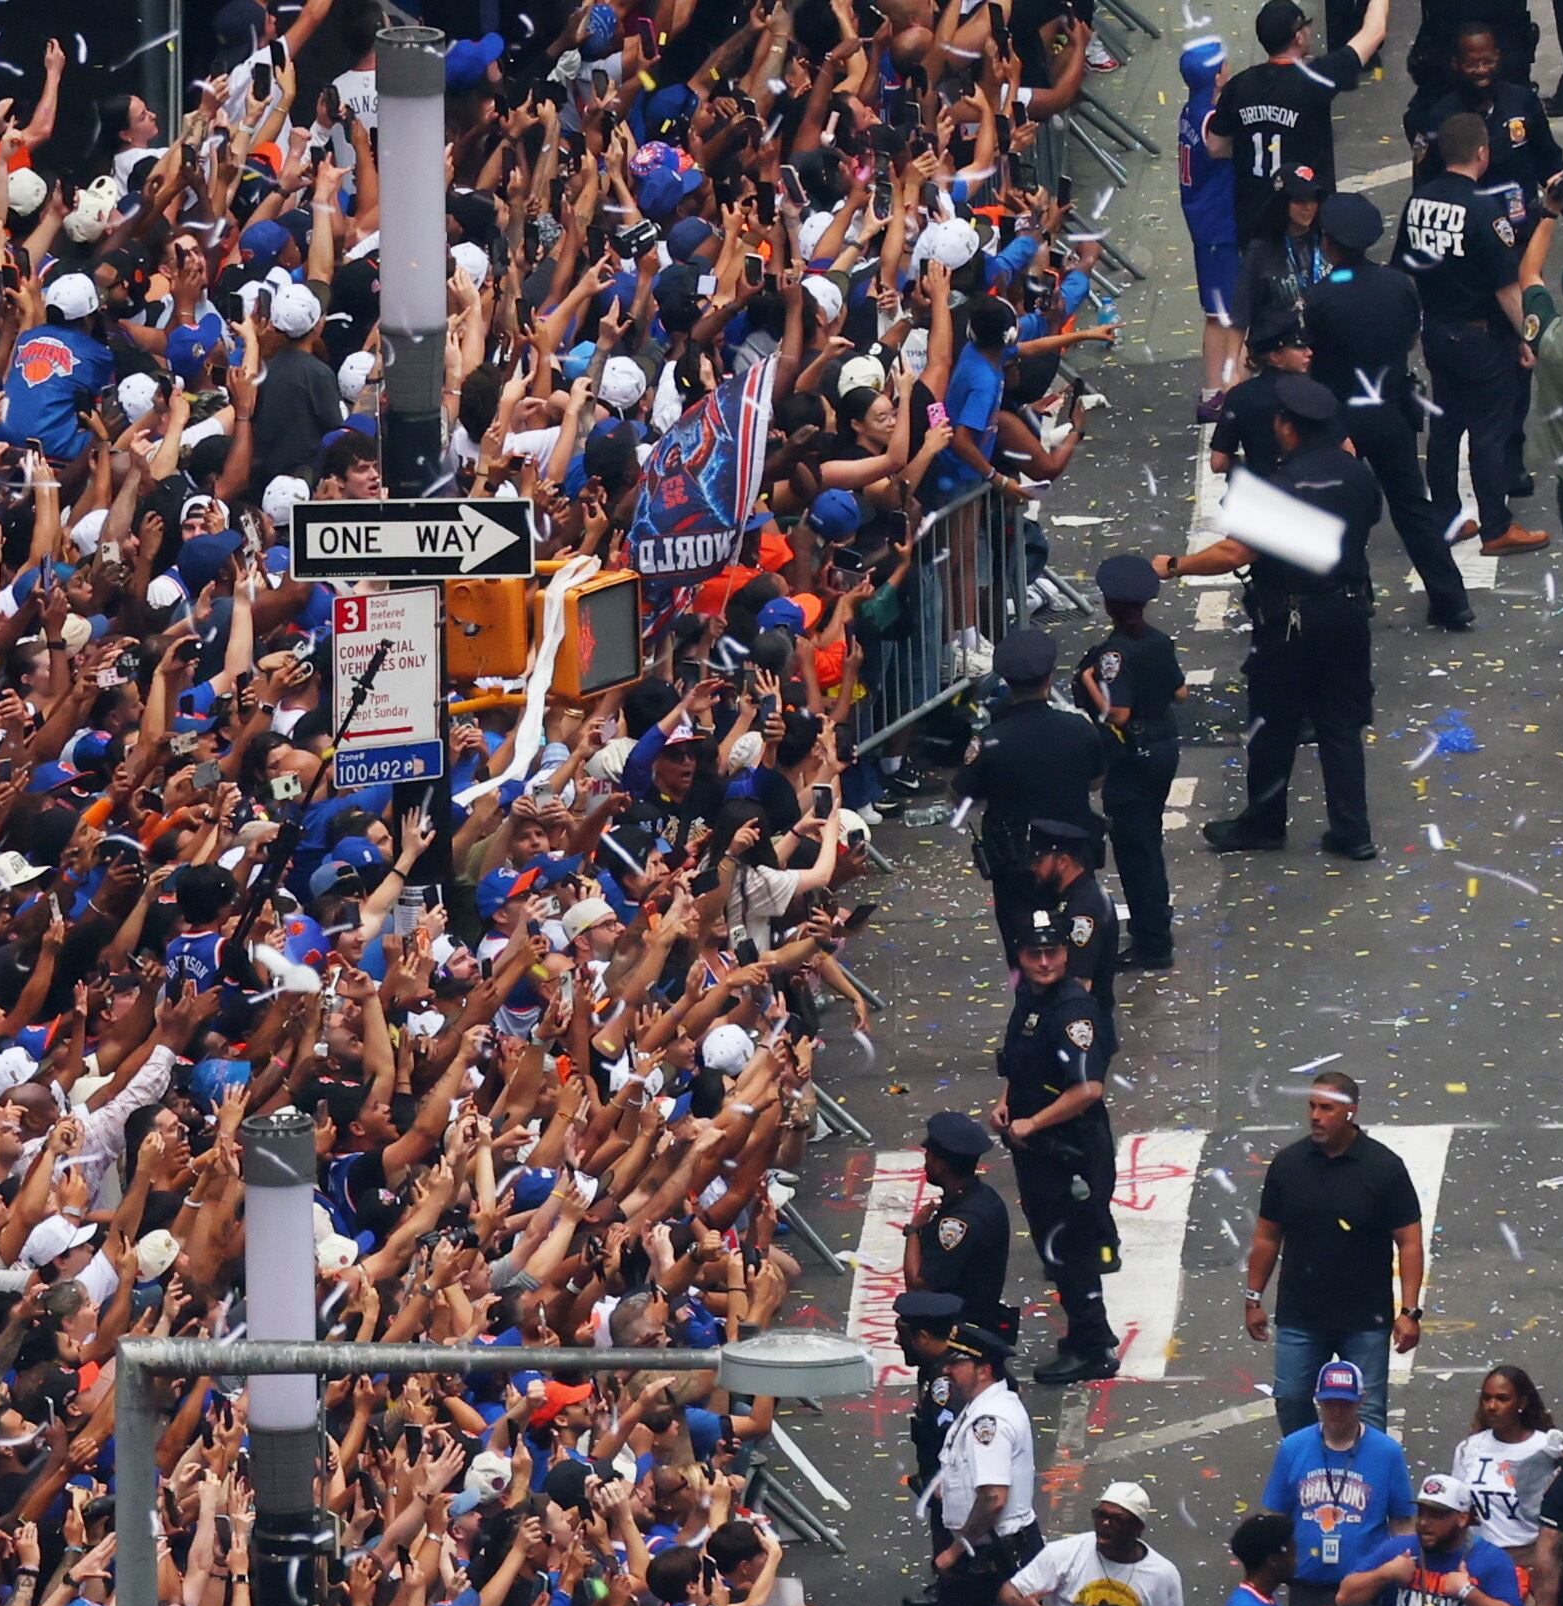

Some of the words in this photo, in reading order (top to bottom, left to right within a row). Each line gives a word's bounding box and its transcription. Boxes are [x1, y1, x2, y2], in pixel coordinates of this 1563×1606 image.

[1239, 106, 1299, 129] BRUNSON
[1252, 132, 1281, 177] 11
[1407, 198, 1467, 236] NYPD
[318, 526, 382, 554] ONE
[416, 525, 484, 553] WAY
[342, 601, 359, 630] 3
[369, 608, 405, 620] metered
[369, 619, 402, 633] parking
[398, 654, 427, 670] ONLY
[369, 693, 390, 707] 7pm
[374, 706, 409, 721] Sunday
[338, 761, 400, 785] 100492
[1472, 1457, 1493, 1485] I
